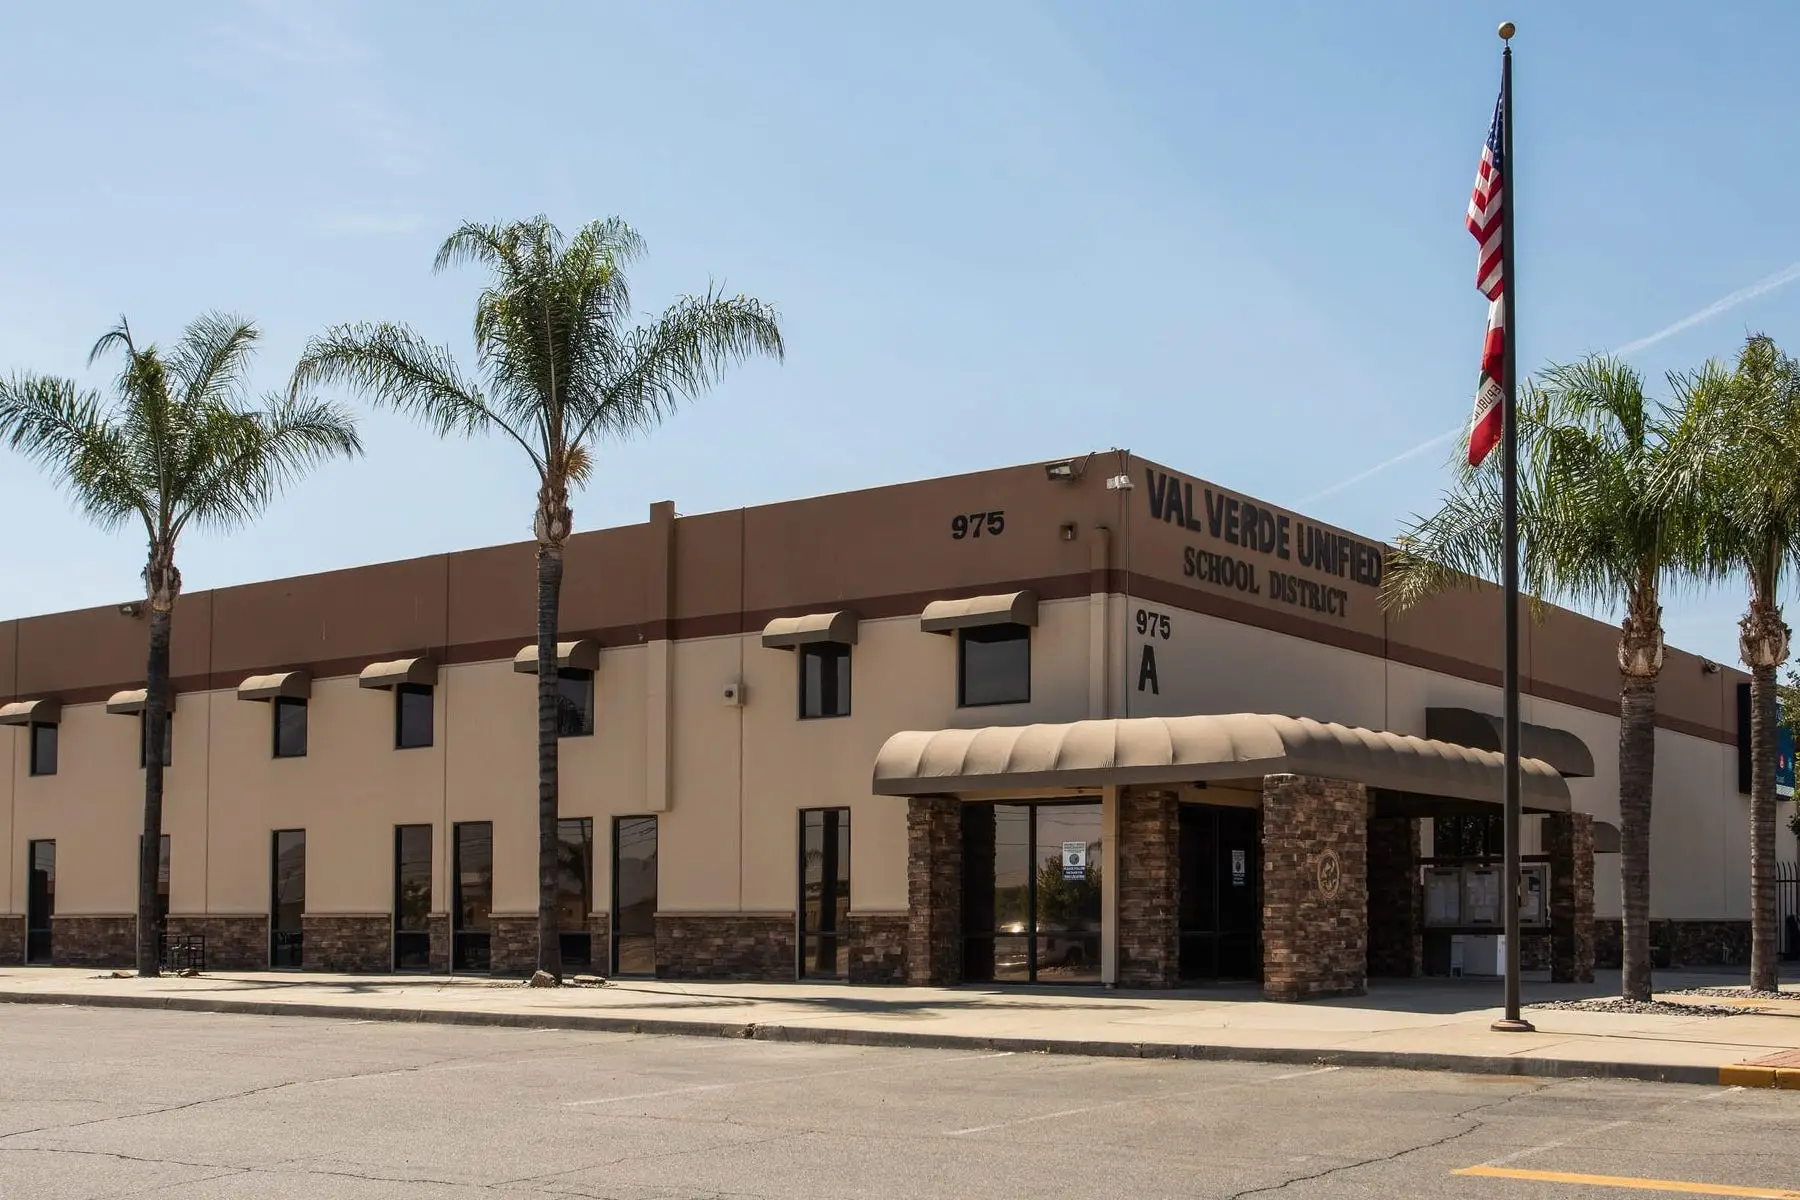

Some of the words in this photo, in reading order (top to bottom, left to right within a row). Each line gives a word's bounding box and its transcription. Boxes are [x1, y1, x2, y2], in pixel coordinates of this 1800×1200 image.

[952, 510, 1005, 540] 975
[1146, 467, 1201, 533] VAL
[1204, 487, 1290, 561] VERDE
[1297, 522, 1382, 587] UNIFIED
[1184, 546, 1259, 594] SCHOOL
[1269, 569, 1348, 617] DISTRICT
[1136, 609, 1170, 640] 975
[1138, 644, 1159, 695] A
